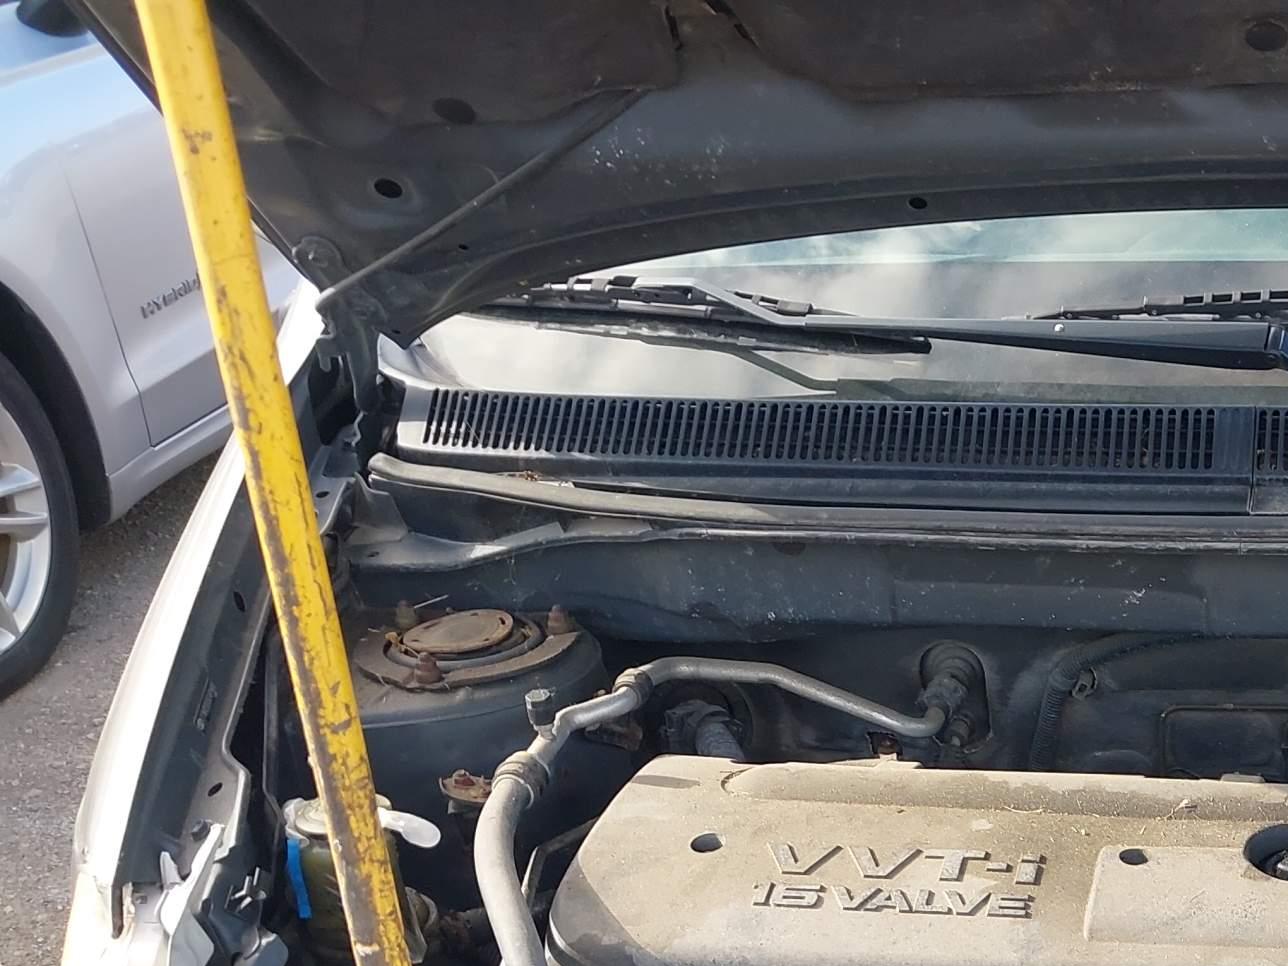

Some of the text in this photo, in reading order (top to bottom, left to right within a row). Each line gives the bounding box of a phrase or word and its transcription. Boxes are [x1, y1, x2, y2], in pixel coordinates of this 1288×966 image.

[766, 842, 1047, 886] VVT-i
[753, 882, 1036, 919] 16 VALVE
